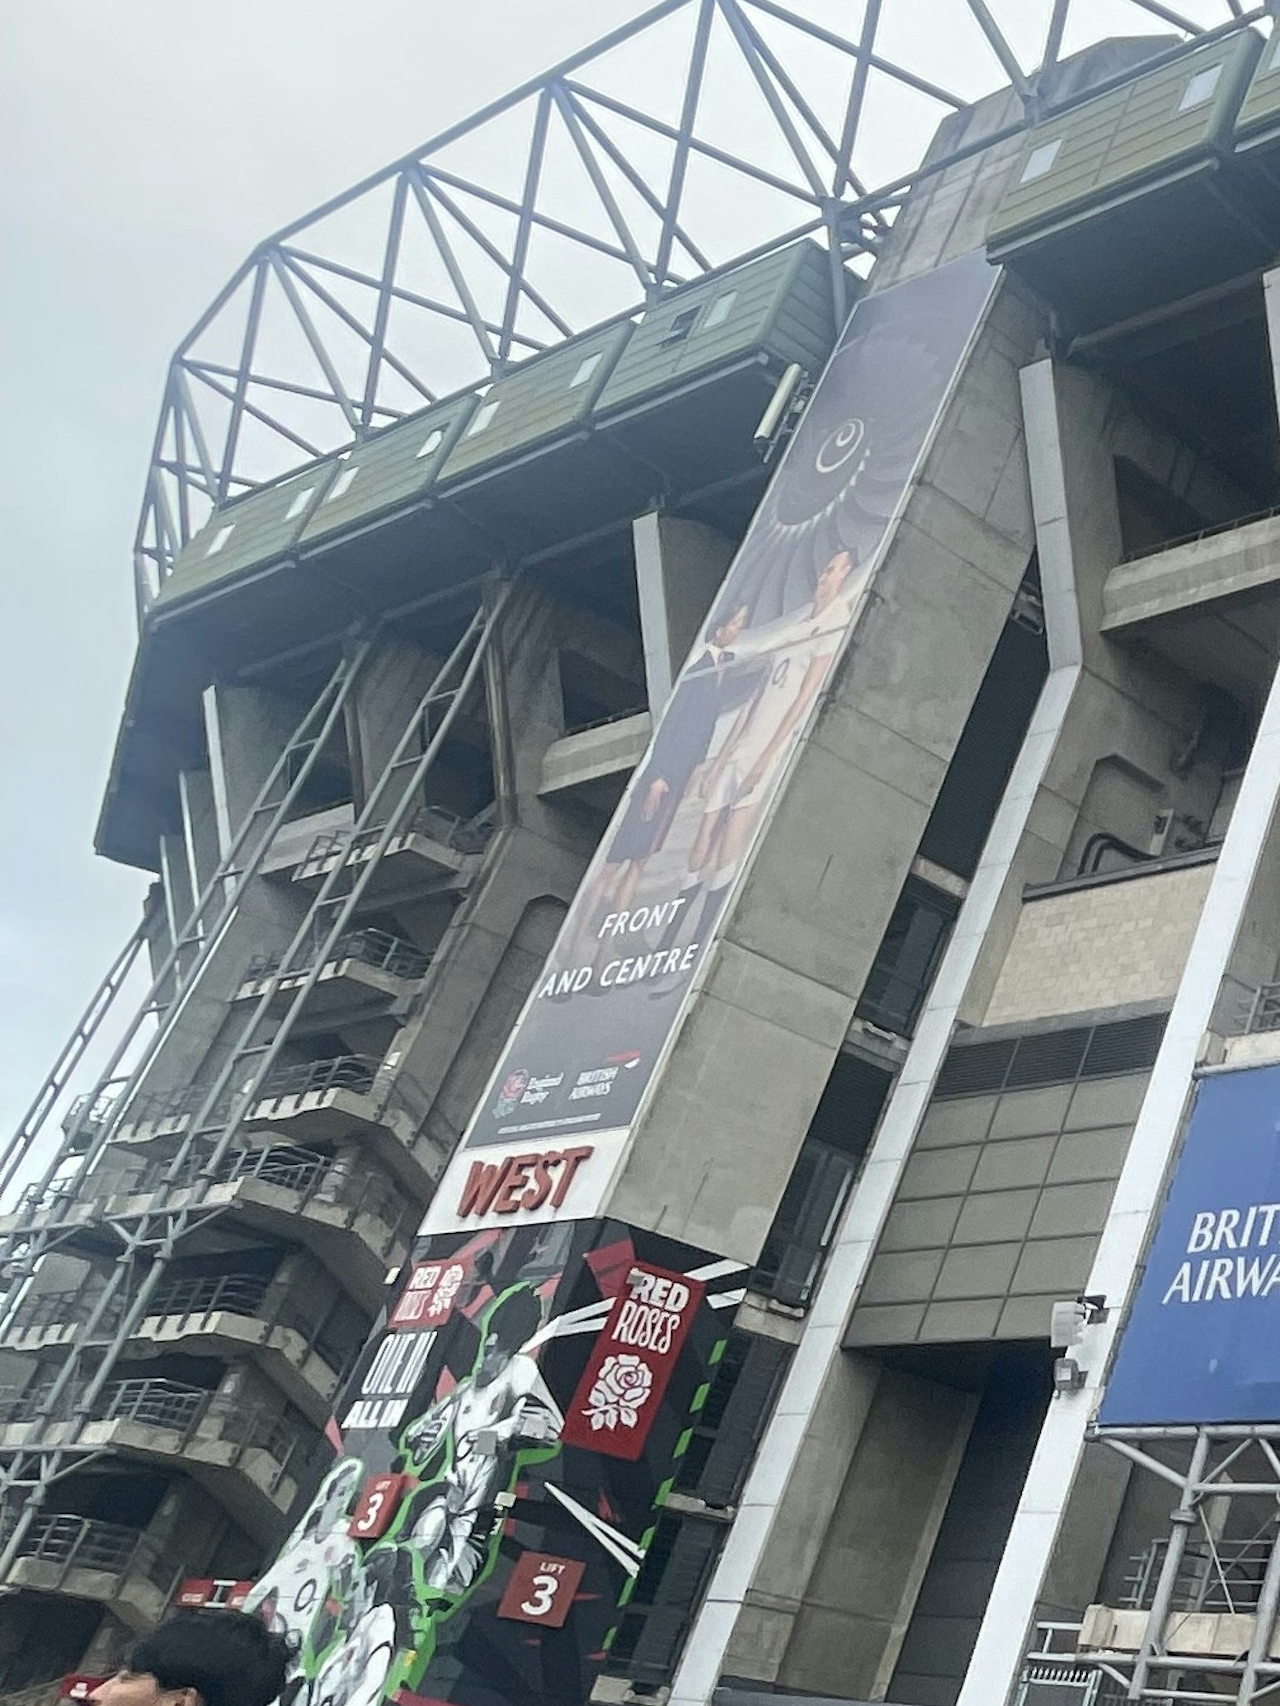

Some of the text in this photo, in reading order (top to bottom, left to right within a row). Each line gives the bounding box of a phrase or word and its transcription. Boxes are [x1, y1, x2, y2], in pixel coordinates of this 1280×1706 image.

[598, 898, 686, 938] FRONT
[538, 944, 699, 999] AND CENTRE
[457, 1145, 595, 1218] WEST
[627, 1267, 690, 1313] RED
[611, 1300, 680, 1354] ROSES
[340, 1400, 384, 1429] ALL
[357, 1493, 385, 1531] 3
[540, 1561, 566, 1574] LIFT
[520, 1575, 559, 1615] 3
